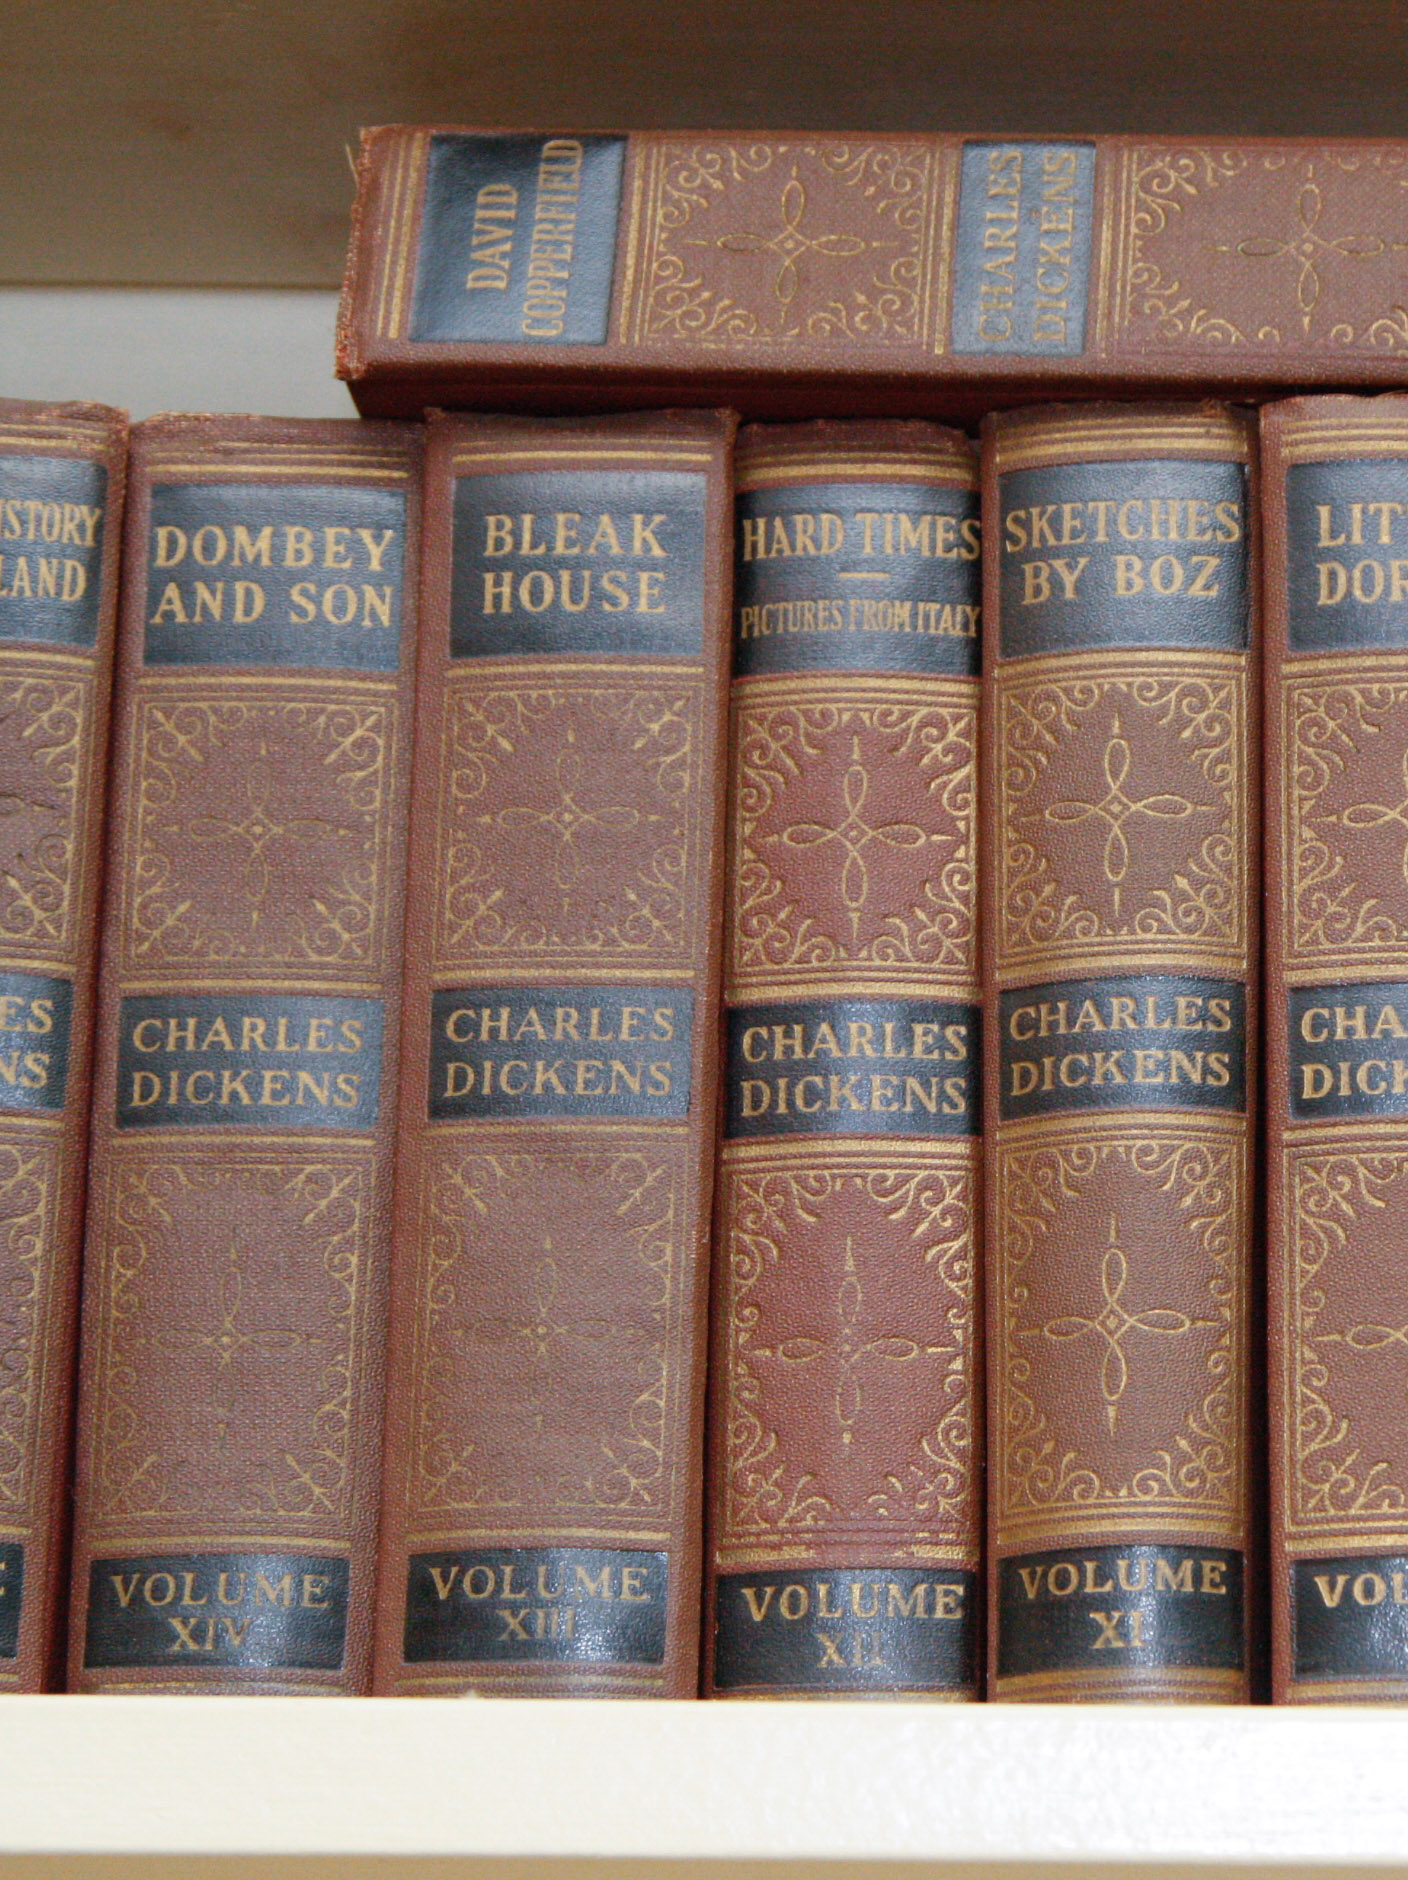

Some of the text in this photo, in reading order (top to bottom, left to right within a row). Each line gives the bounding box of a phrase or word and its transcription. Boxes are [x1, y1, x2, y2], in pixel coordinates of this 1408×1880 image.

[467, 183, 519, 290] DAVID
[521, 139, 583, 336] COPPERFIELD
[978, 151, 1023, 342] CHARLES
[1034, 152, 1078, 343] DICKENS
[484, 513, 669, 557] BLEAK
[742, 513, 981, 561] HARD TIMES
[1005, 499, 1240, 552] SKETCHES
[154, 524, 394, 571] DOMBEY
[482, 571, 668, 615] HOUSE
[1021, 555, 1220, 605] BY BOZ
[150, 581, 393, 628] AND SON
[741, 600, 981, 639] PICTURES FROM ITALY
[133, 1017, 364, 1053] CHARLES
[446, 1006, 674, 1043] CHARLES
[1010, 995, 1231, 1041] CHARLES
[742, 1021, 968, 1064] CHARLES
[131, 1069, 360, 1109] DICKENS
[444, 1060, 673, 1098] DICKENS
[1010, 1049, 1230, 1097] DICKENS
[742, 1076, 968, 1117] DICKENS
[109, 1572, 331, 1609] VOLUME
[429, 1566, 650, 1600] VOLUME
[1019, 1560, 1227, 1600] VOLUME
[742, 1584, 965, 1622] VOLUME
[168, 1616, 251, 1651] XIV
[499, 1609, 576, 1641] XIII
[1090, 1610, 1145, 1649] XI
[815, 1632, 883, 1669] XII
